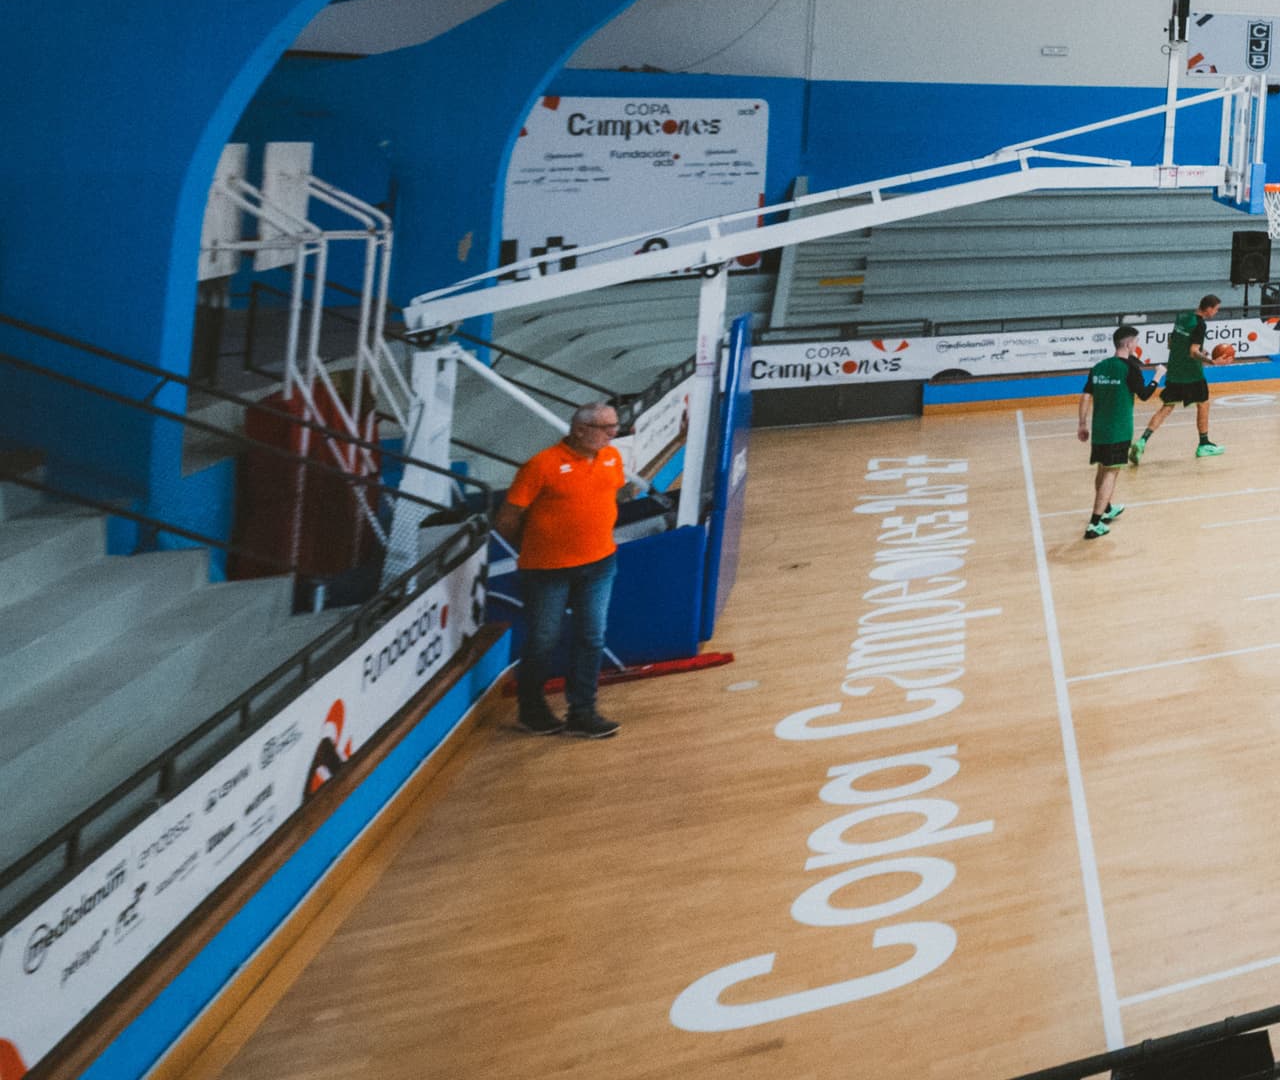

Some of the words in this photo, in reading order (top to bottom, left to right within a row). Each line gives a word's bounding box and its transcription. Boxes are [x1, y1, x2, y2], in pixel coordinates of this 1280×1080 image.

[624, 103, 671, 116] COPA
[568, 113, 721, 142] Campeones
[609, 150, 671, 160] Fundación
[653, 159, 675, 168] acb
[805, 345, 851, 360] COPA
[751, 356, 903, 382] Campeones
[774, 509, 1002, 741] Campeones
[362, 601, 438, 693] Fundación
[416, 634, 442, 677] acb
[668, 745, 995, 1033] Copa
